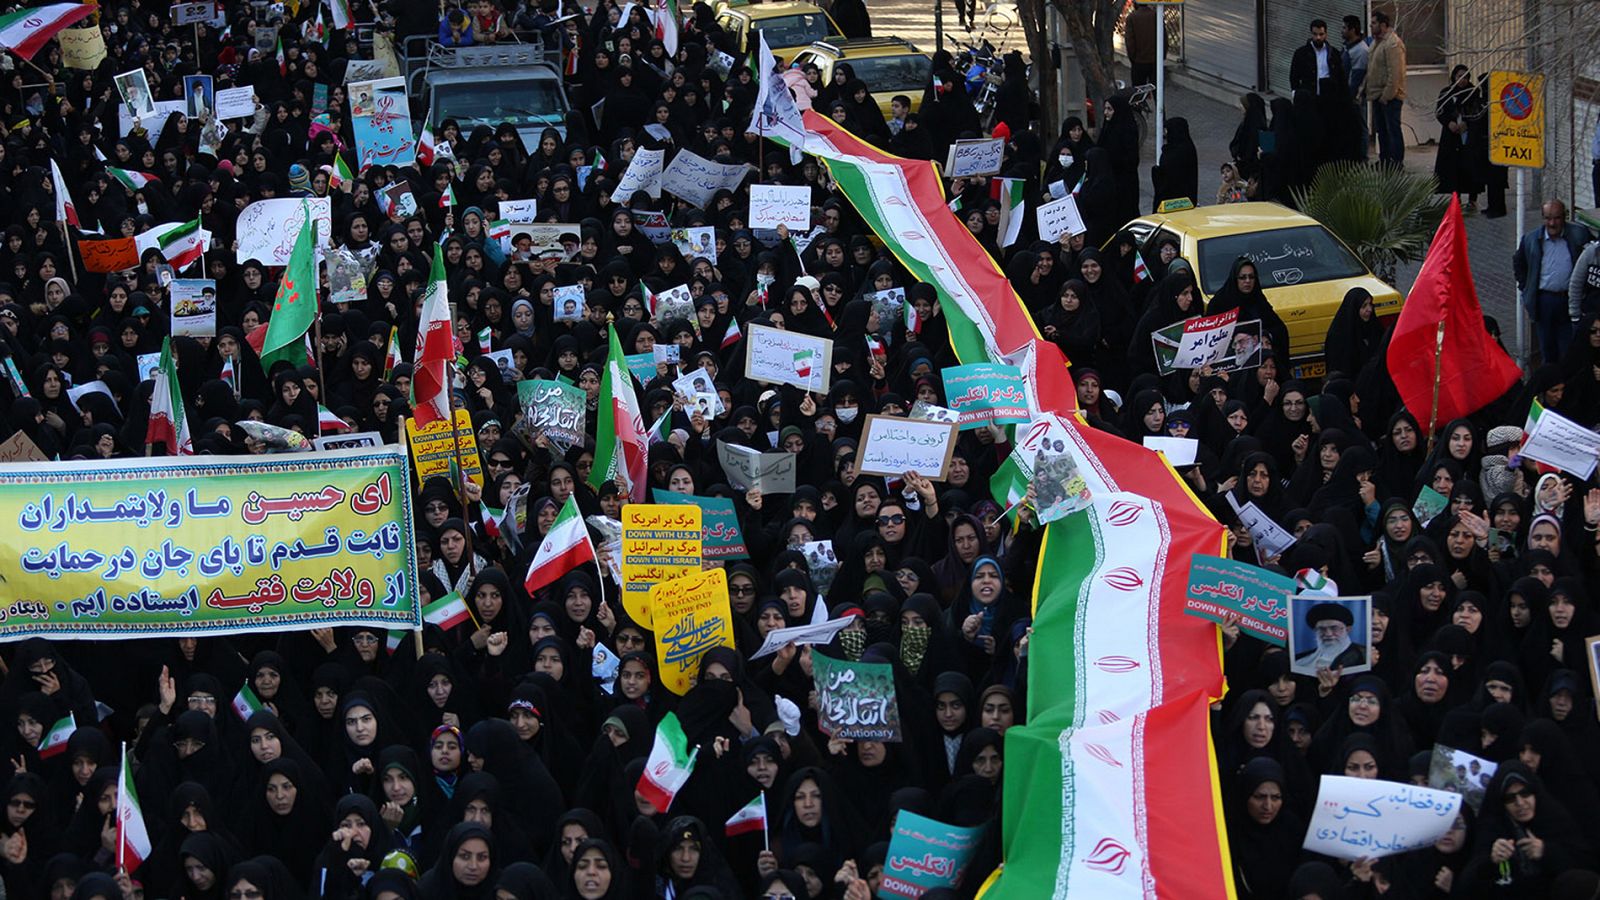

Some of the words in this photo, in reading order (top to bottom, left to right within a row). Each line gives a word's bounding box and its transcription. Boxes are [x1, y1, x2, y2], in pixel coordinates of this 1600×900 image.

[378, 137, 413, 163] حضرت
[1503, 145, 1532, 160] TAXI
[1189, 333, 1209, 351] امر
[535, 383, 563, 403] من
[950, 384, 989, 408] انگلیس
[989, 388, 1001, 403] بر
[1002, 385, 1024, 403] مرگ
[958, 414, 975, 423] OWN
[977, 410, 993, 420] WITH
[994, 408, 1028, 417] ENGLAND
[414, 434, 435, 443] DOWN
[436, 430, 453, 440] WITH
[872, 428, 909, 442] اختلاس
[418, 440, 445, 454] اسرائیل
[447, 440, 456, 451] بر
[418, 453, 437, 462] DOWN
[460, 457, 477, 468] مرگ
[186, 489, 230, 520] ما
[353, 474, 391, 515] ای
[20, 489, 181, 531] ولایتمداران
[243, 485, 345, 525] حسین
[631, 513, 661, 527] امریکا
[663, 517, 674, 528] بر
[675, 513, 695, 527] مرگ
[346, 520, 401, 560] ثابت
[628, 531, 653, 539] DOWN
[654, 531, 675, 539] WITH
[677, 532, 699, 540] U.S.A
[708, 522, 738, 542] مرگ
[142, 538, 192, 578] جان
[199, 537, 241, 575] پای
[244, 536, 266, 566] تا
[271, 526, 340, 570] قدم
[629, 541, 663, 555] اسرائیل
[664, 545, 675, 556] بر
[677, 541, 697, 555] مرگ
[702, 545, 744, 556] ENGLAND
[20, 541, 103, 578] حمایت
[103, 545, 136, 580] در
[628, 556, 651, 564] DOWN
[652, 557, 672, 565] WITH
[673, 557, 698, 565] ISRAEL
[628, 567, 665, 582] انگلیس
[206, 576, 287, 613] فقیه
[291, 568, 374, 609] ولایت
[382, 569, 406, 607] از
[1190, 581, 1245, 602] انگلیس
[71, 588, 106, 617] ایم
[112, 586, 199, 613] ایستاده
[663, 601, 676, 610] WE
[676, 594, 703, 607] STAND
[702, 590, 713, 598] UP
[1240, 595, 1258, 611] بر
[1258, 598, 1289, 620] مرگ
[7, 601, 50, 620] پایگاه
[667, 611, 679, 619] TO
[679, 606, 695, 615] THE
[696, 602, 712, 611] END
[1187, 600, 1217, 613] DOWN
[1241, 616, 1285, 637] ENGLAND
[827, 663, 855, 691] من
[1333, 795, 1387, 820] کو
[1434, 794, 1457, 817] قوه
[1315, 826, 1372, 849] اقتصادی
[889, 852, 956, 878] انگلیس
[883, 877, 918, 897] DOWN
